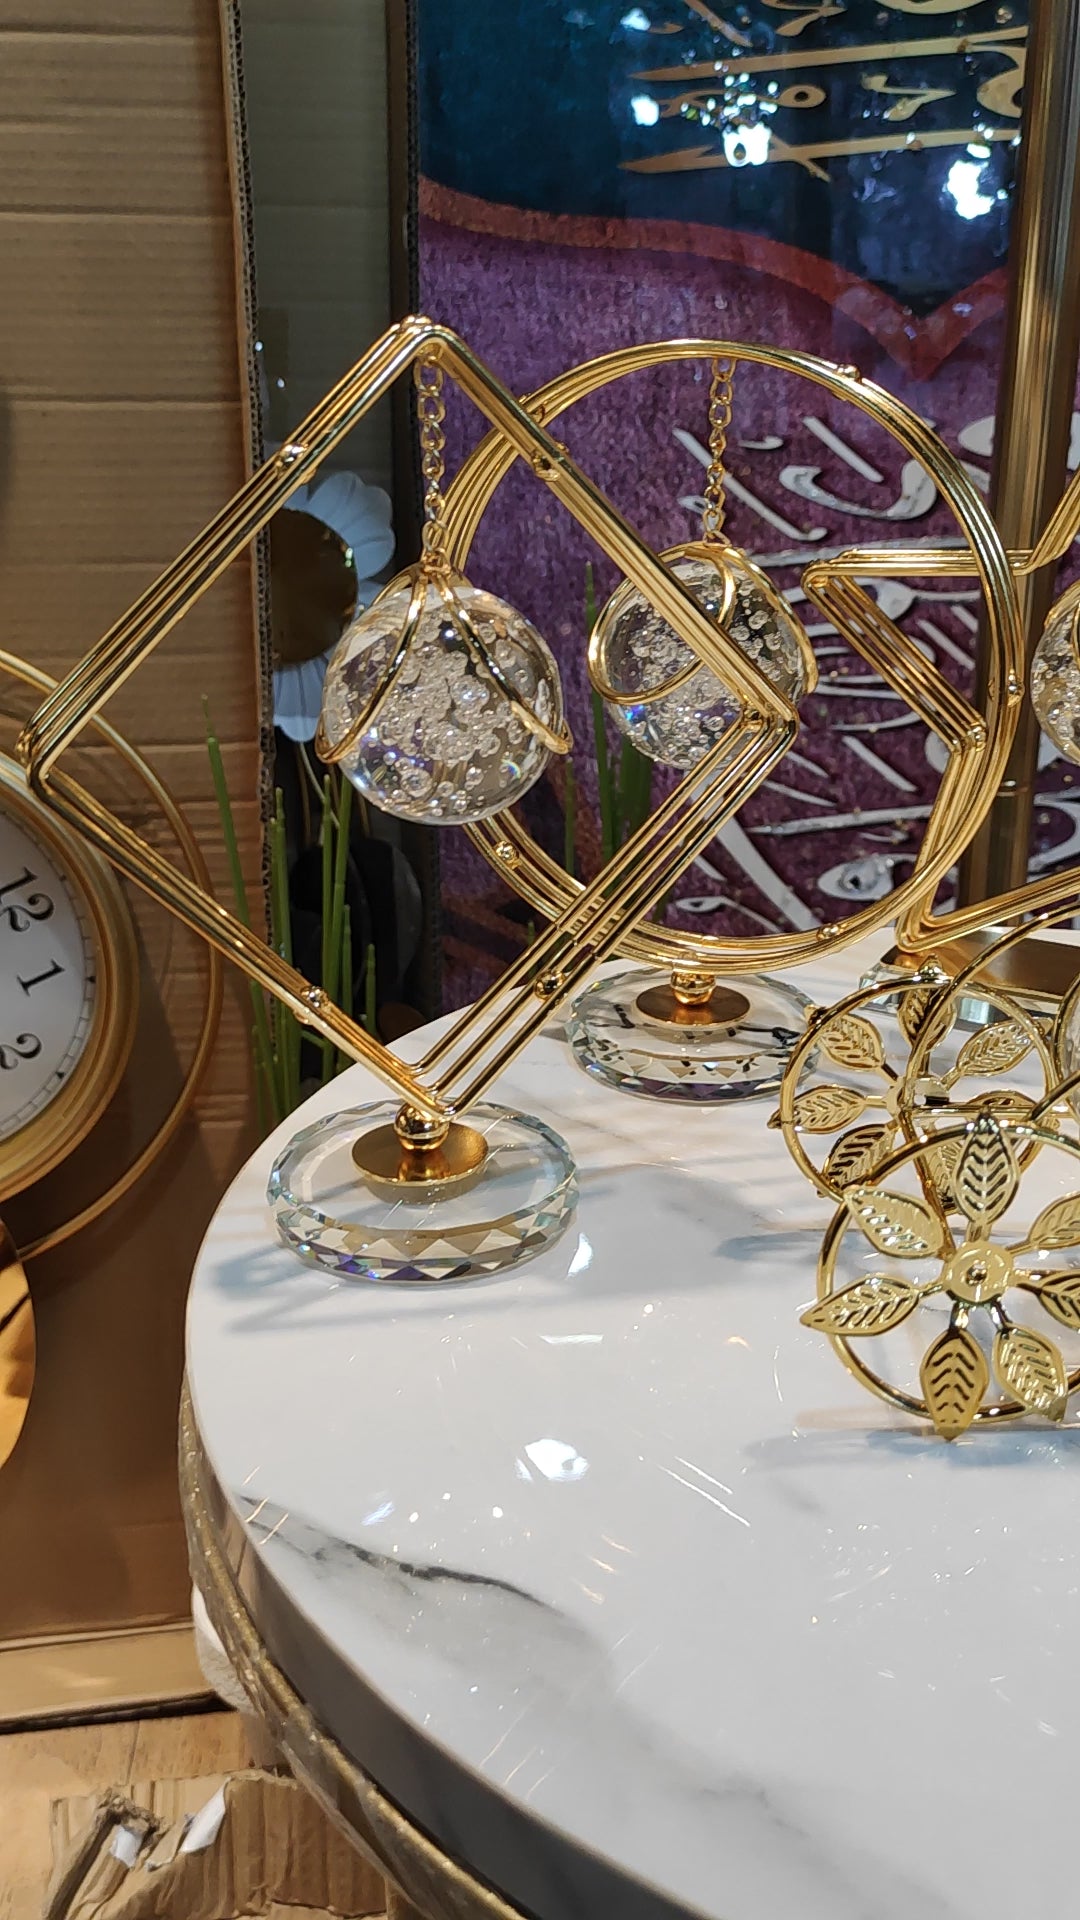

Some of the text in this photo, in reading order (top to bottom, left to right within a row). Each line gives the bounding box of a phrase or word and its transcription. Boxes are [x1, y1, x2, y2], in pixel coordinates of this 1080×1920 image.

[0, 866, 55, 933] 12
[16, 958, 66, 997] 1
[0, 1033, 42, 1071] 2
